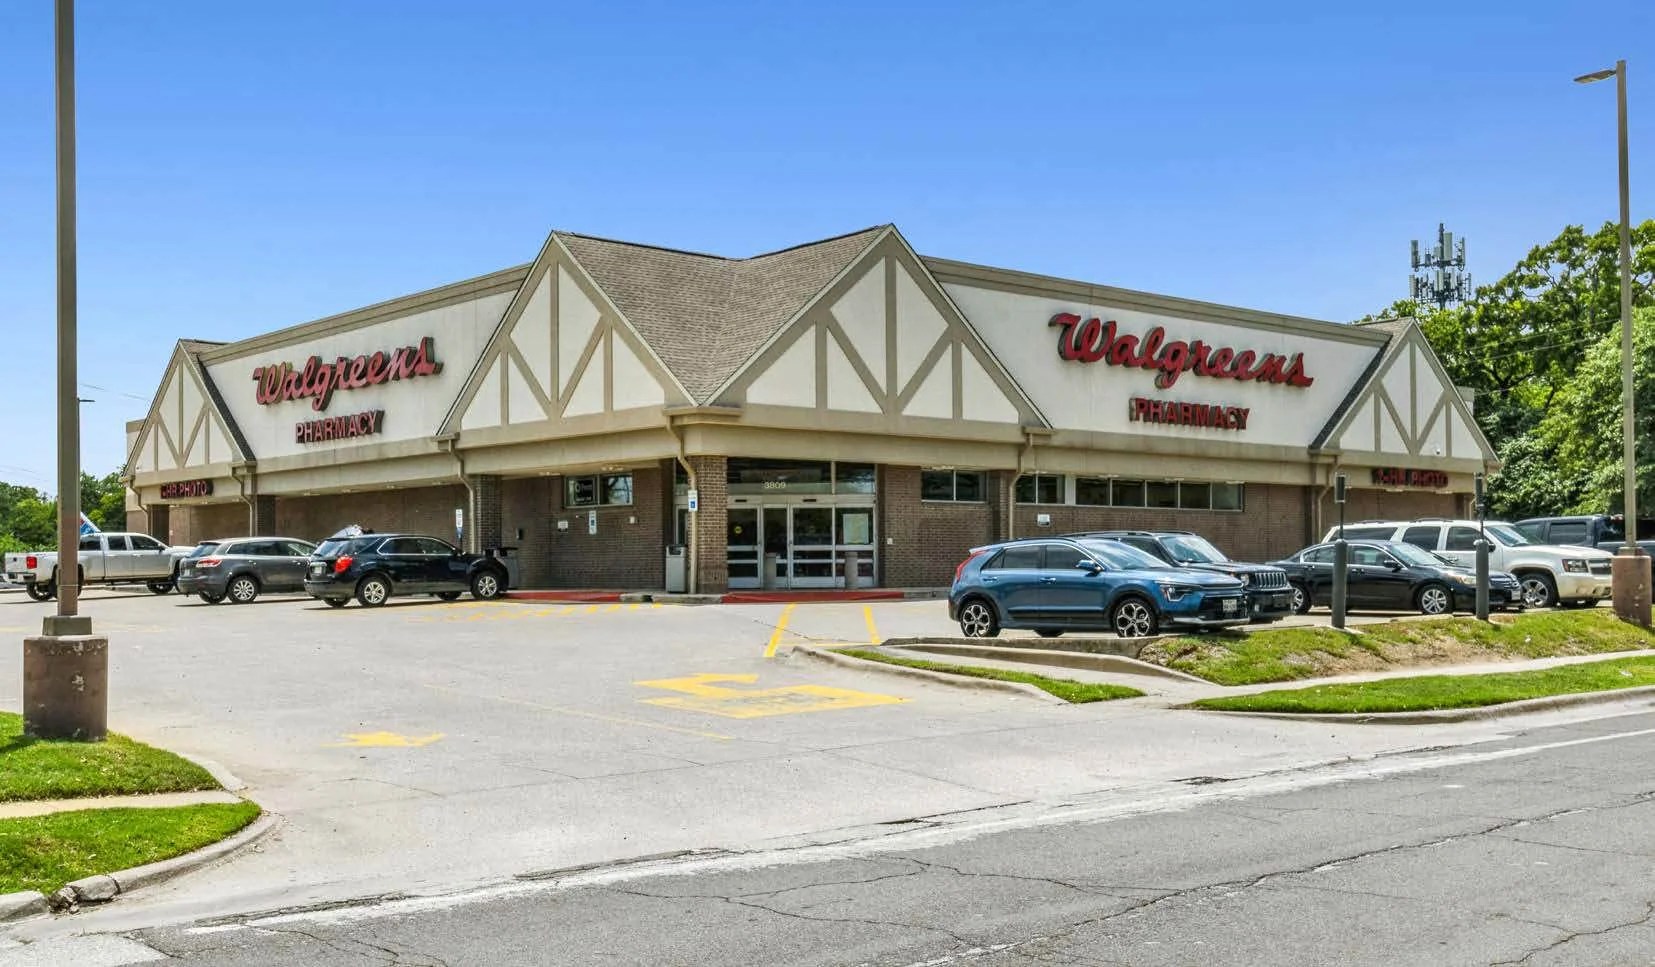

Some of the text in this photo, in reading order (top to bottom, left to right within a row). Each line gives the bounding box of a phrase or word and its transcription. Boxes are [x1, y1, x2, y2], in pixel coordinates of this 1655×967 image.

[1048, 312, 1315, 389] Walgreens
[253, 336, 441, 411] Walgreens
[295, 410, 384, 443] PHARMACY
[1129, 397, 1250, 430] PHARMACY
[179, 479, 209, 497] PHOTO
